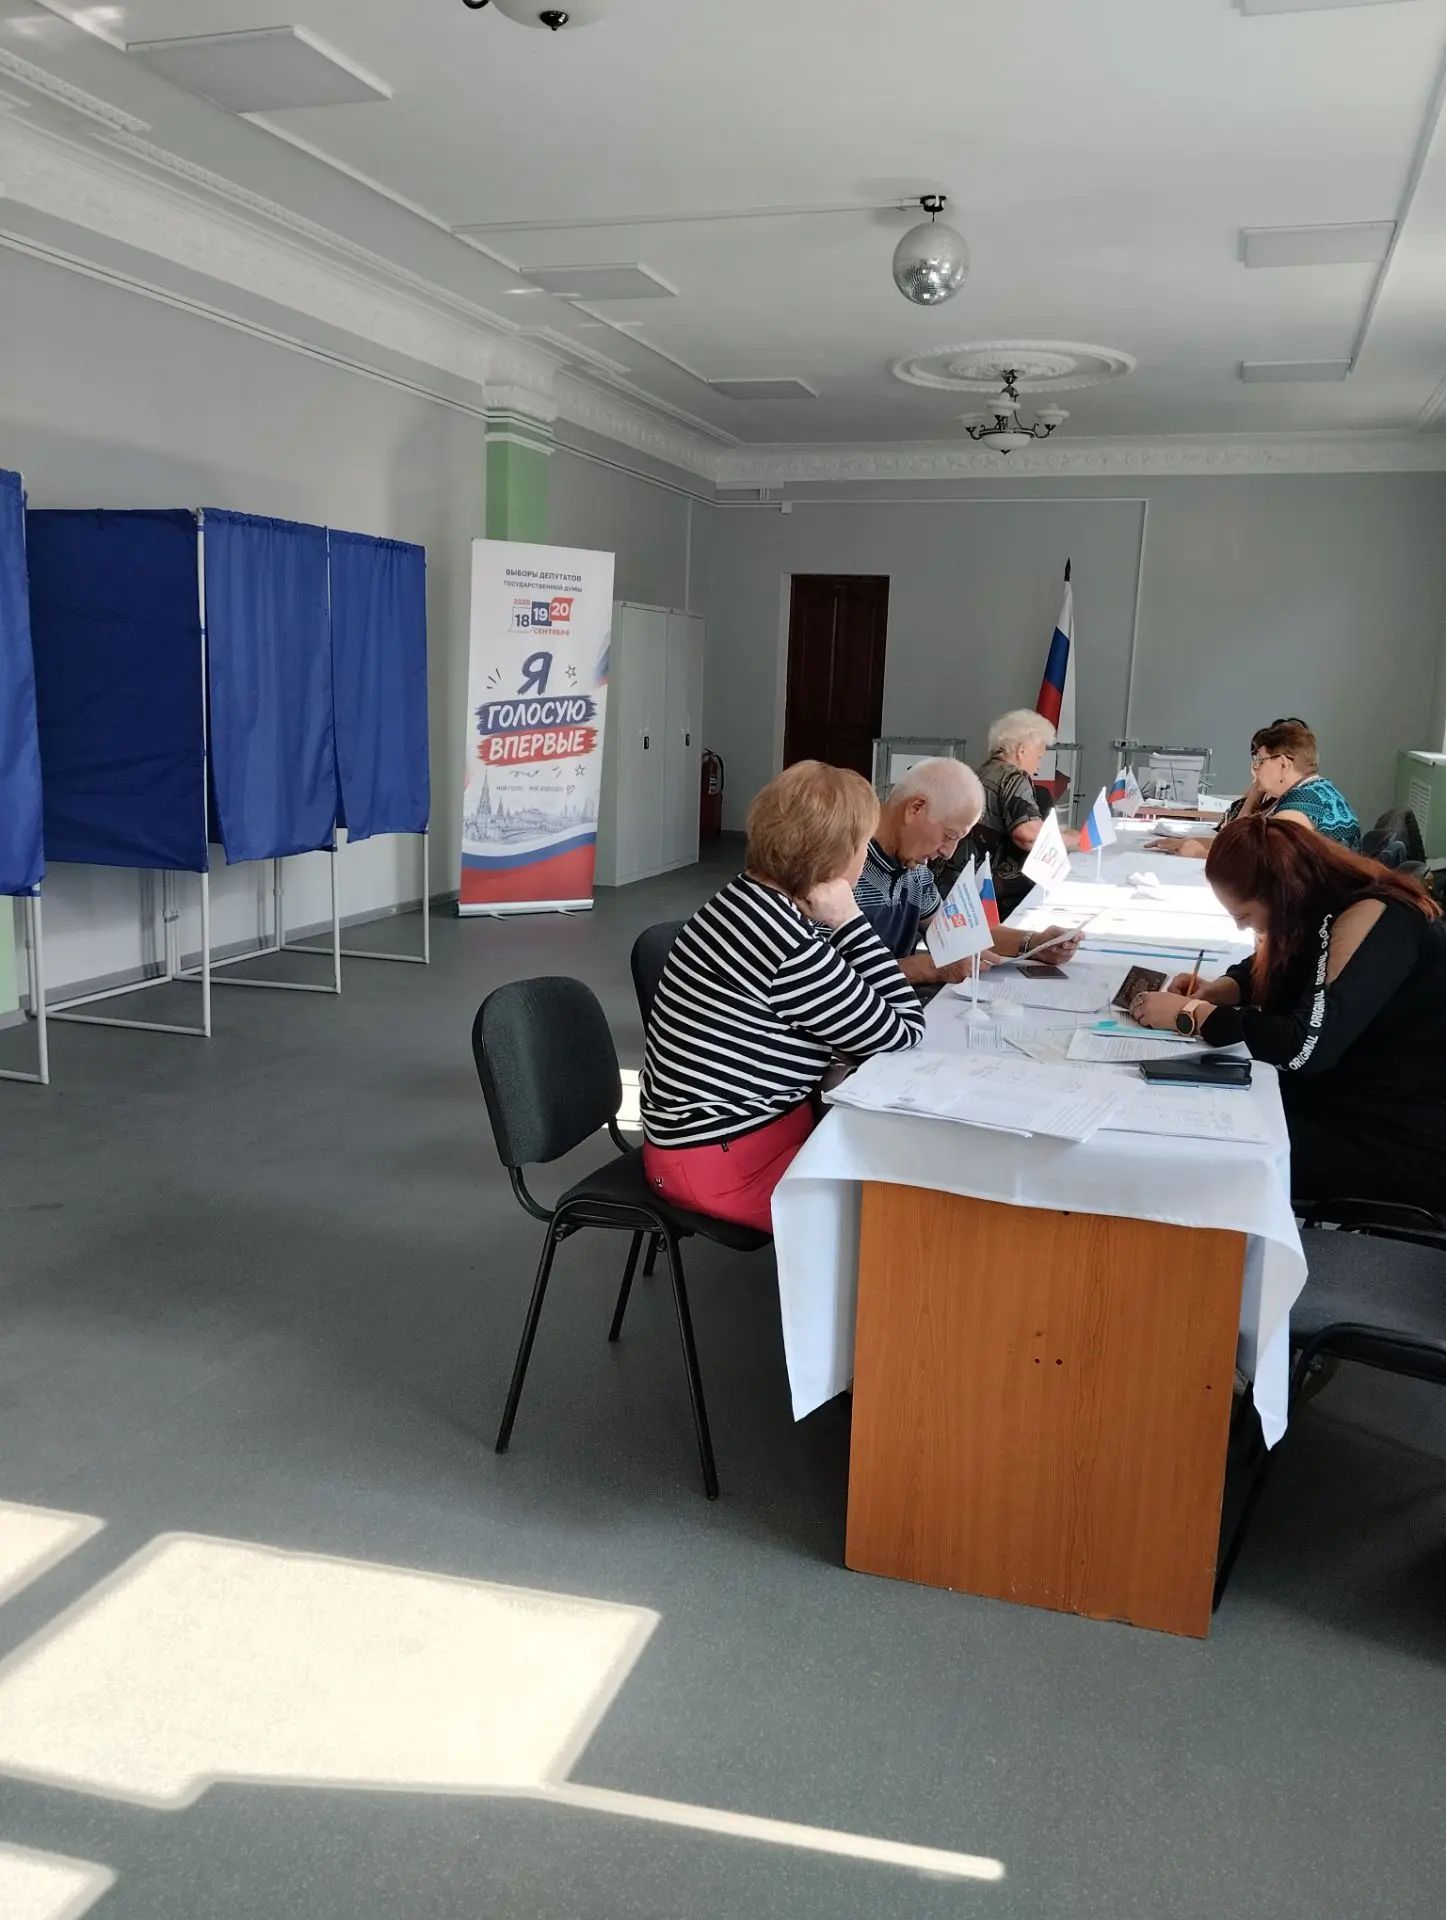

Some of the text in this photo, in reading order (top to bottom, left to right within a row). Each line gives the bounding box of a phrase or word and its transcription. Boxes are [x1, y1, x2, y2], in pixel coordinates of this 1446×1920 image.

[504, 580, 563, 591] ГОСУДАРСТВЕННОЙ
[506, 569, 582, 582] ВЫБОРЫ ДЕПУТАТОВ
[515, 602, 569, 628] 18 19 20
[534, 627, 571, 636] СЕНТЯБРЯ
[517, 651, 553, 696] Я
[487, 700, 587, 729] ГОЛОСУЮ
[488, 729, 588, 761] ВПЕРВЫЕ
[1288, 1034, 1319, 1071] ORIGINAL
